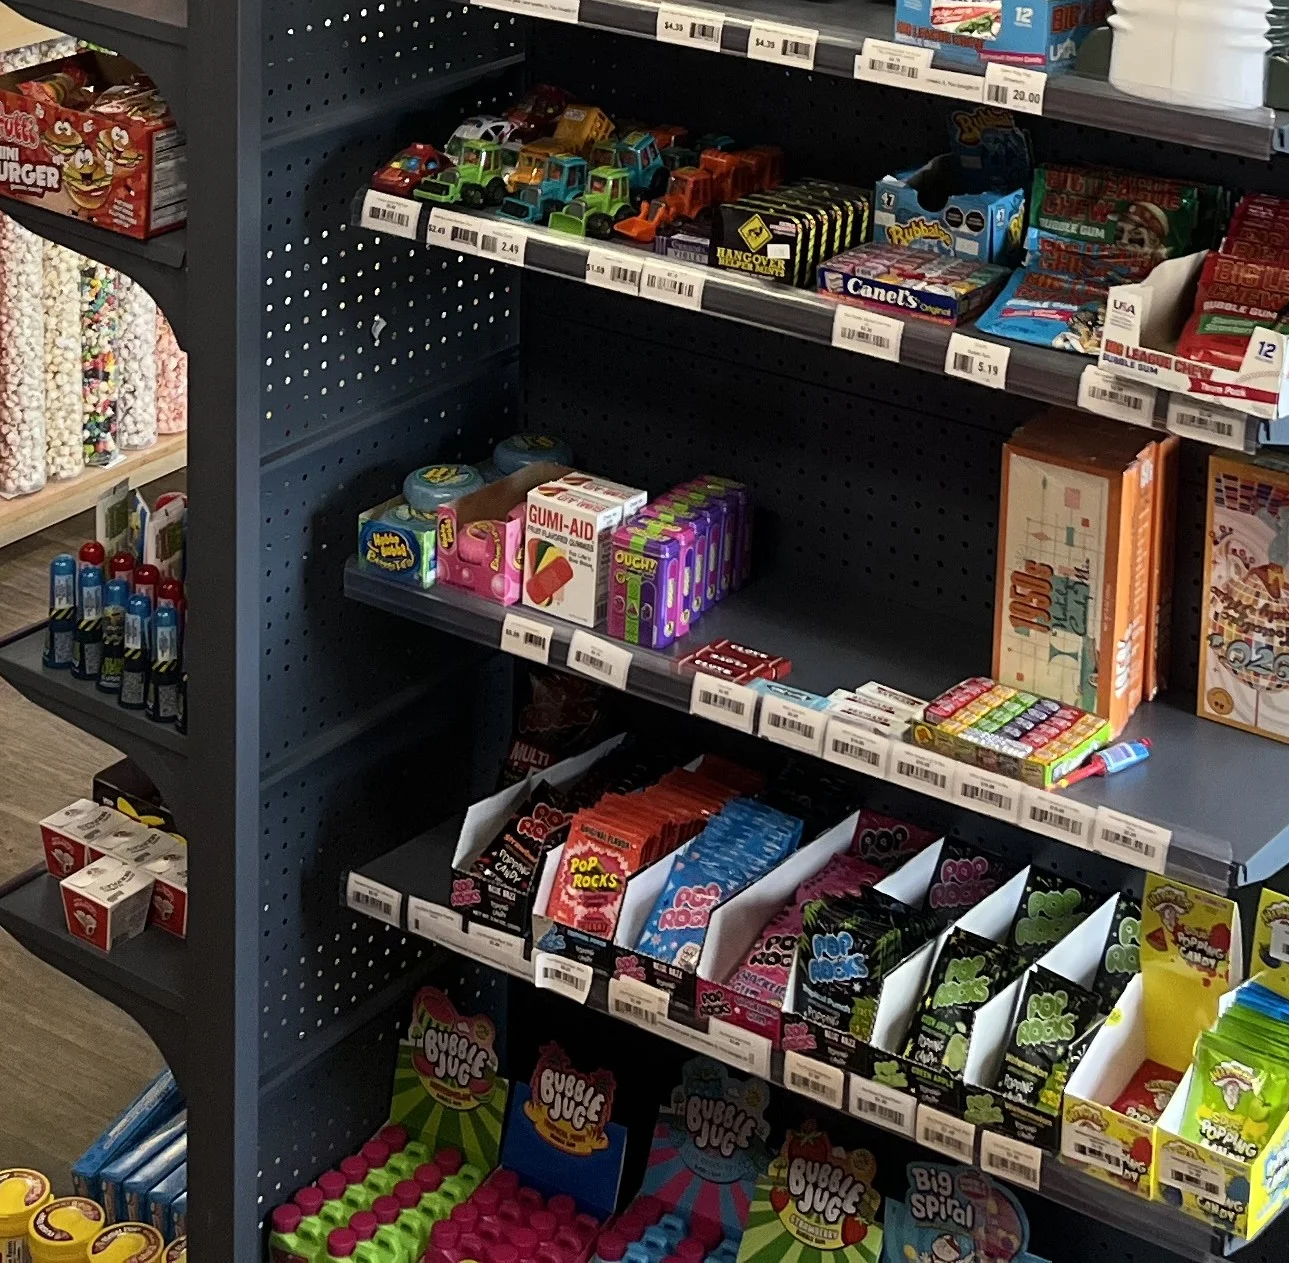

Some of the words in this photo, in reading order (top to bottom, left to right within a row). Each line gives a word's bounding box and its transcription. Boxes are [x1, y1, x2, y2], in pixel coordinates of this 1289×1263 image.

[1015, 7, 1032, 23] 12
[1013, 90, 1040, 103] 20.00
[502, 242, 519, 254] 2.49
[717, 247, 786, 270] HANGOVER
[718, 256, 753, 272] HELPER
[754, 262, 786, 278] MINTS
[847, 277, 918, 309] Canel's
[920, 303, 952, 317] Original
[1113, 299, 1136, 316] USA
[1203, 301, 1247, 315] BUBBLE
[1249, 305, 1278, 318] GUM
[1105, 339, 1124, 356] BIG
[1125, 345, 1172, 370] LEAGUE
[1174, 359, 1213, 380] CHEW
[1258, 341, 1276, 359] 12
[978, 361, 999, 377] 5.19
[529, 506, 593, 540] GUMI-AID
[615, 551, 657, 571] OUGH!
[510, 741, 550, 766] MULTI
[494, 862, 522, 884] CANDY
[498, 848, 531, 876] POPPING
[570, 856, 598, 873] POP
[573, 873, 618, 889] ROCKS
[424, 1027, 489, 1079] BUBBLE
[434, 1053, 471, 1087] JUG
[540, 1068, 605, 1123] BUBBLE
[549, 1092, 587, 1130] JUG
[788, 1157, 864, 1214] BUBBLE
[911, 1167, 954, 1196] Big
[797, 1189, 841, 1223] JUG
[911, 1193, 974, 1229] Spiral
